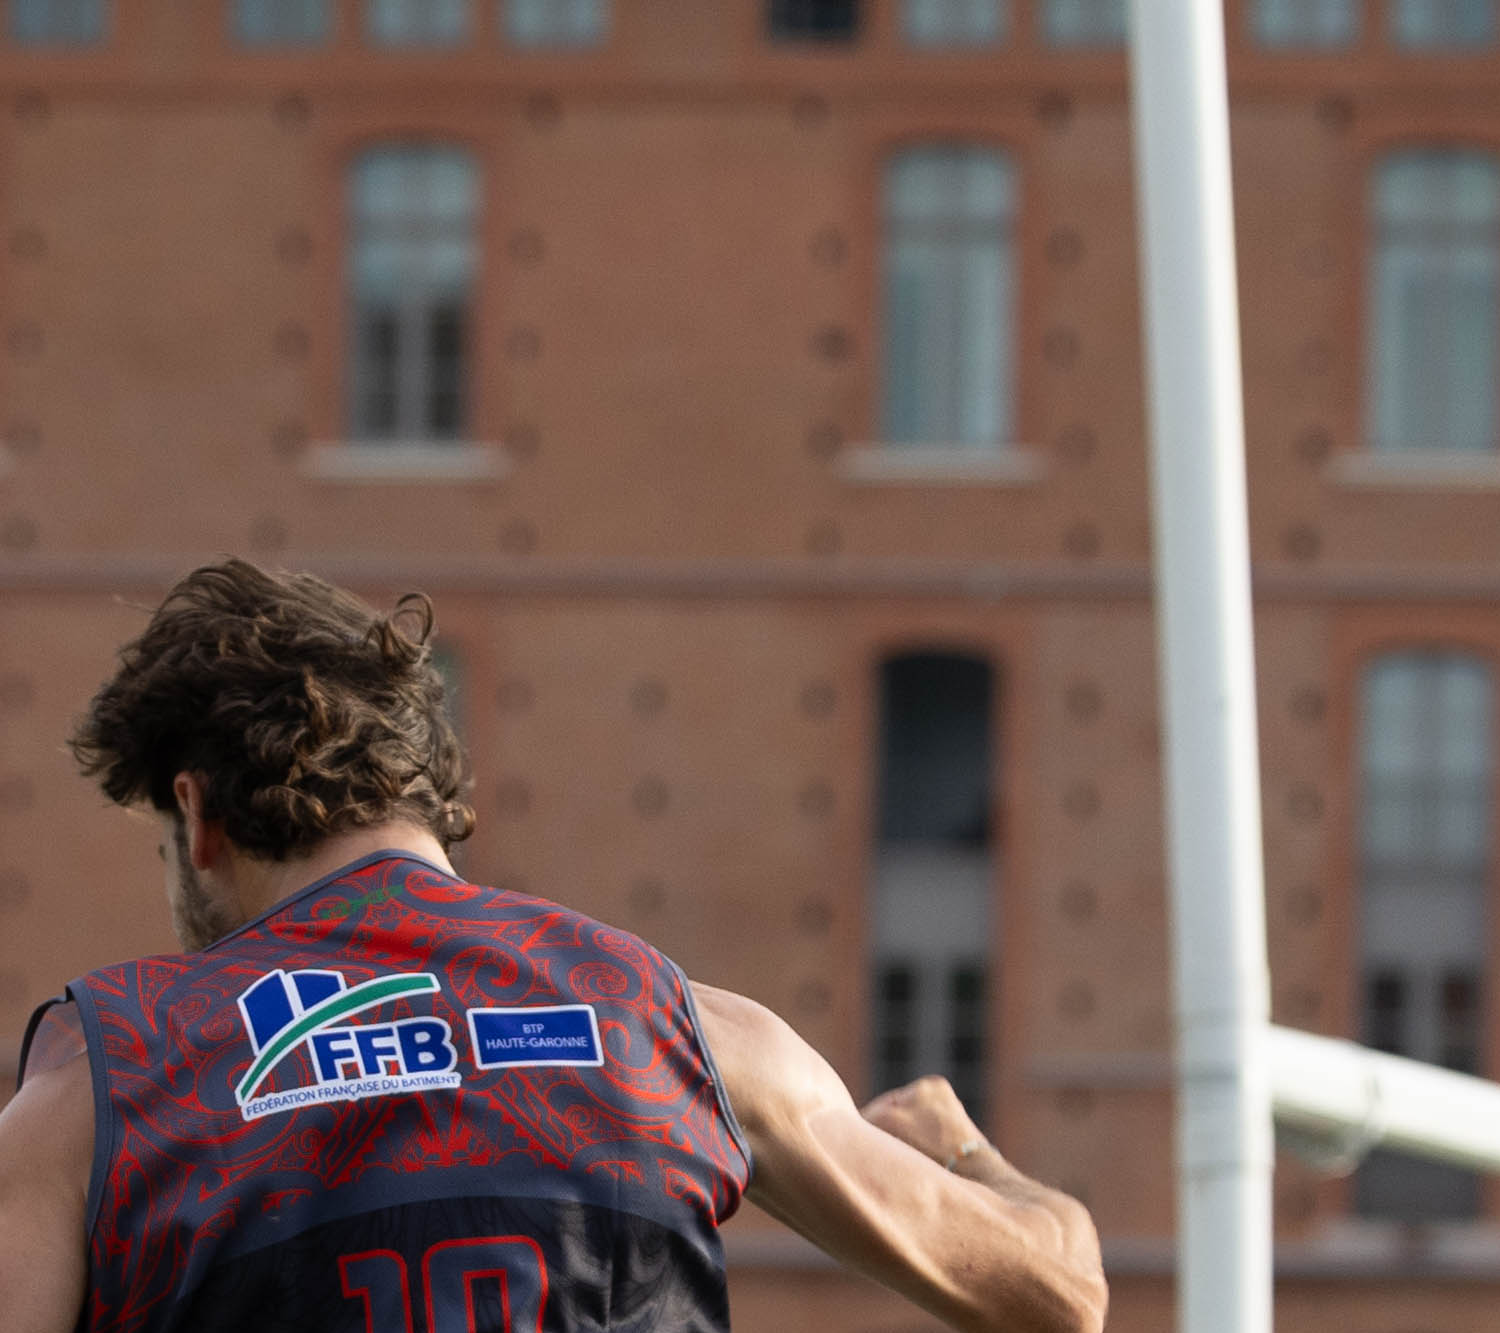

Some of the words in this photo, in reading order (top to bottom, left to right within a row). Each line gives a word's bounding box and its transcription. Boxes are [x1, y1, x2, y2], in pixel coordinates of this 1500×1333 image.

[521, 1023, 545, 1035] BTP
[311, 1021, 453, 1082] FFB
[485, 1036, 589, 1050] HAUTE-GARONNE
[246, 1090, 316, 1117] FÉDÉRATION
[317, 1080, 380, 1101] FRANÇAISE
[382, 1077, 400, 1091] DU
